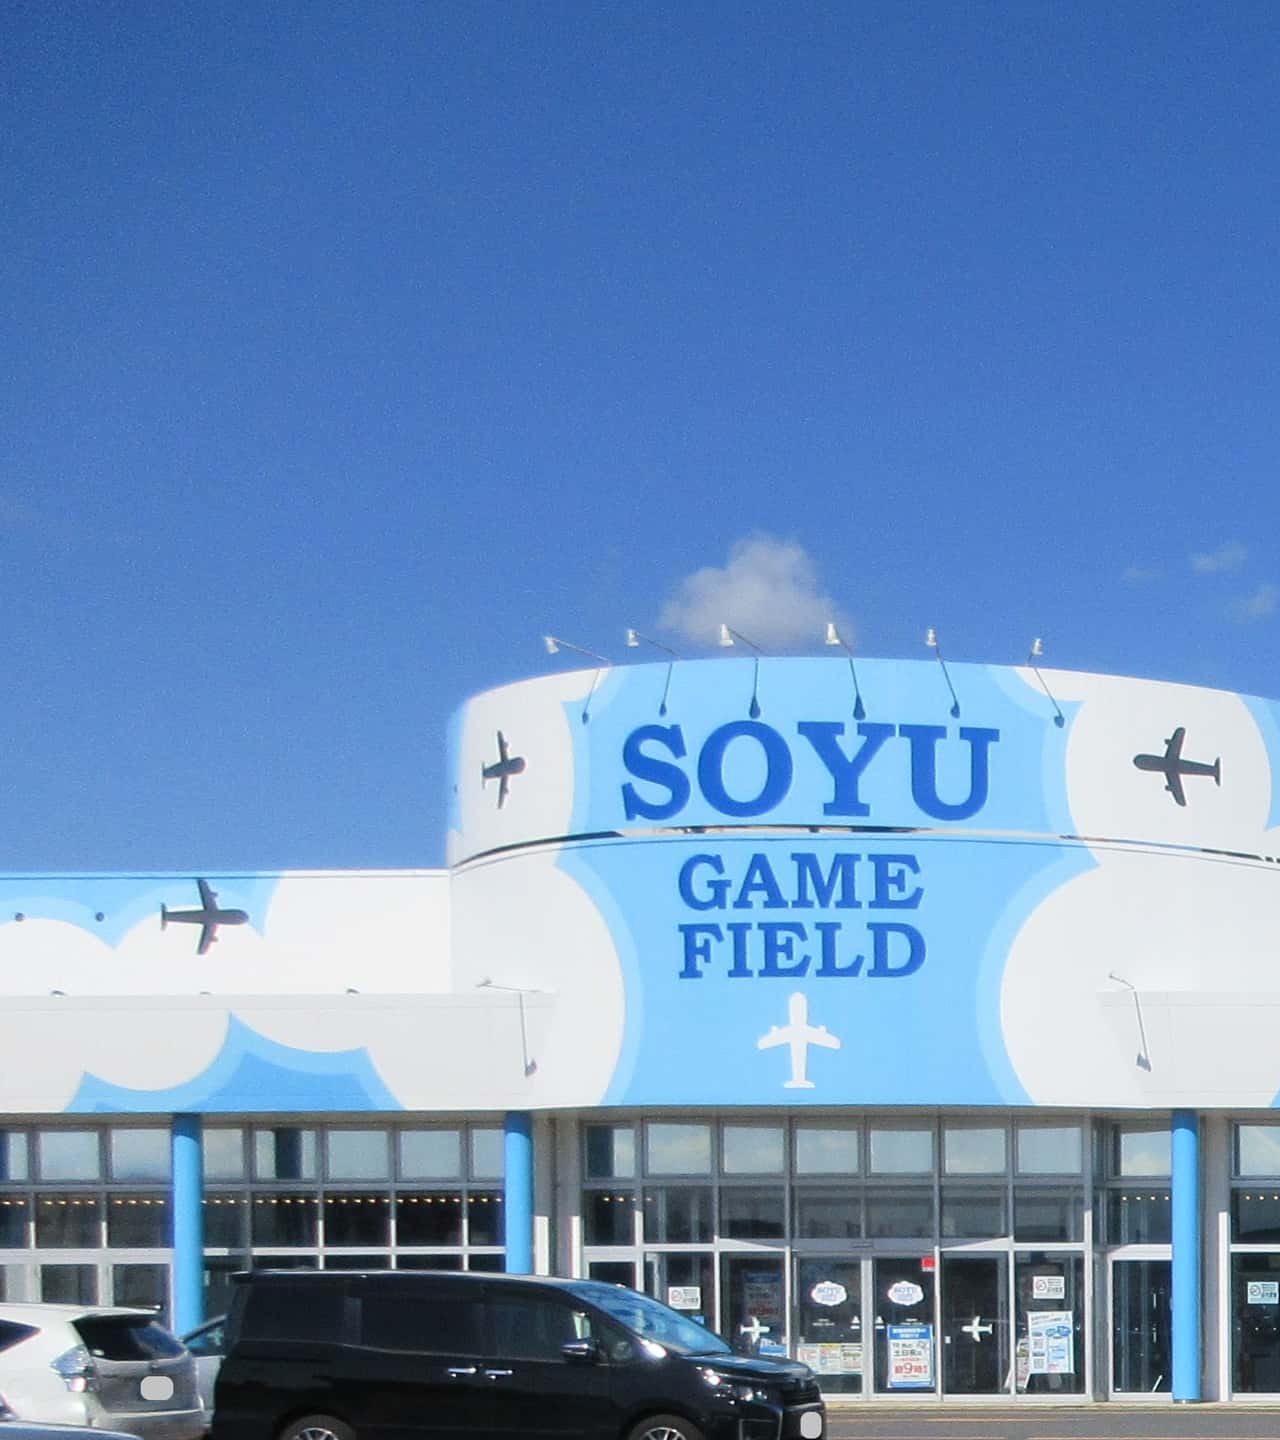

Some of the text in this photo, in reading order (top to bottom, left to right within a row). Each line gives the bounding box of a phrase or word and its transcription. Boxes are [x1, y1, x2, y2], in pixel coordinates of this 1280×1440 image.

[621, 719, 1000, 822] SOYU
[677, 852, 924, 912] GAME
[677, 921, 926, 980] FIELD
